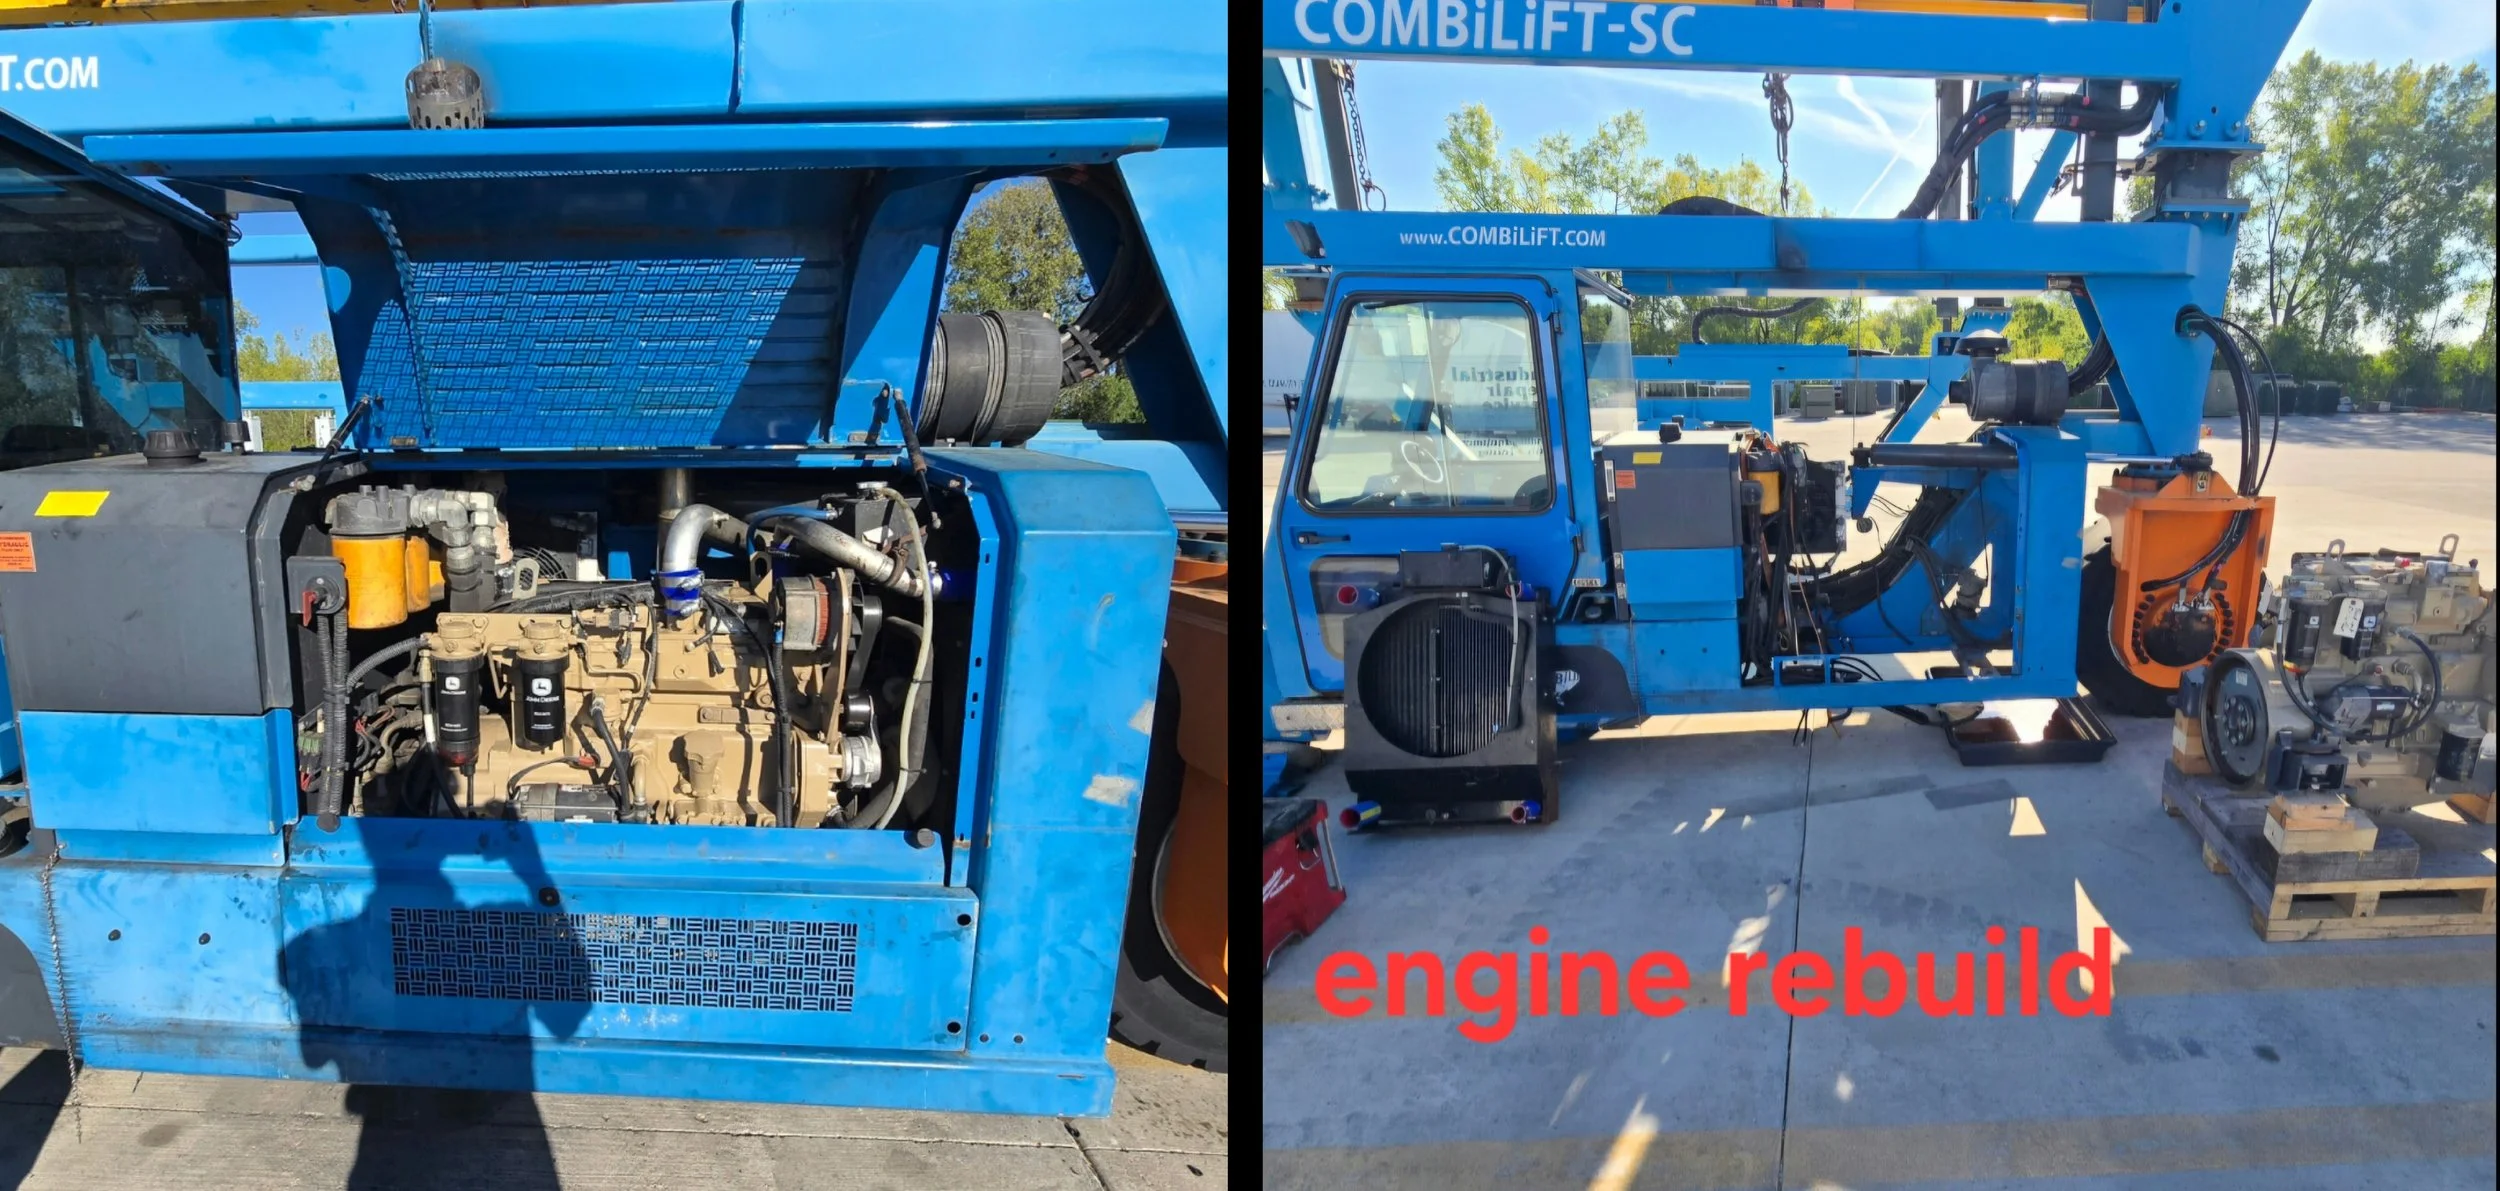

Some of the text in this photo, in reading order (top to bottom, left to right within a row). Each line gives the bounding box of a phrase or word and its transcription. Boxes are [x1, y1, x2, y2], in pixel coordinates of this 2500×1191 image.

[1294, 0, 1696, 56] COMBiLiFT-SC
[0, 54, 99, 92] T.COM
[1399, 225, 1606, 247] www.COMBiLiFT.COM
